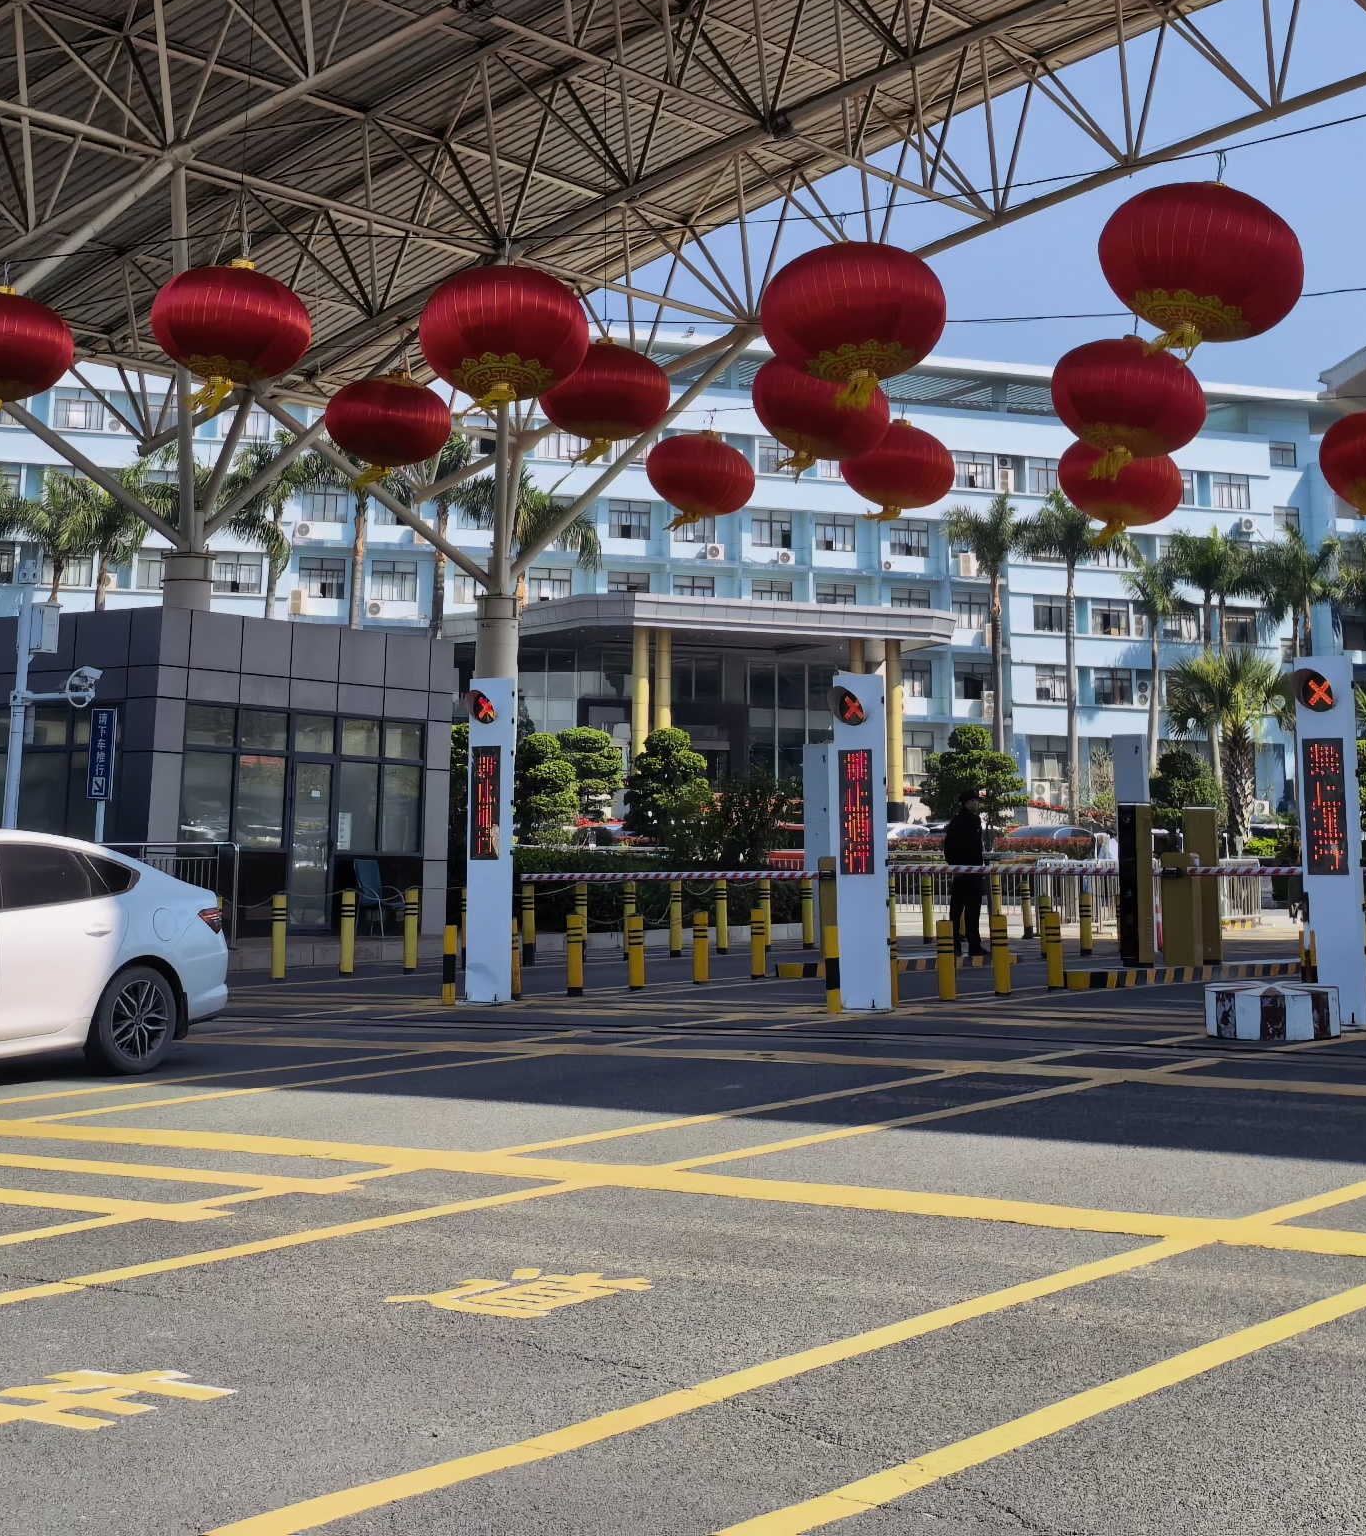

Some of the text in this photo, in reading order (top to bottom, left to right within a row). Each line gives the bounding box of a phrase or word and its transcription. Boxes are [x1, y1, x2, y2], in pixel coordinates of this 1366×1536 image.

[96, 712, 109, 776] 请下车推行
[383, 1267, 654, 1319] 道
